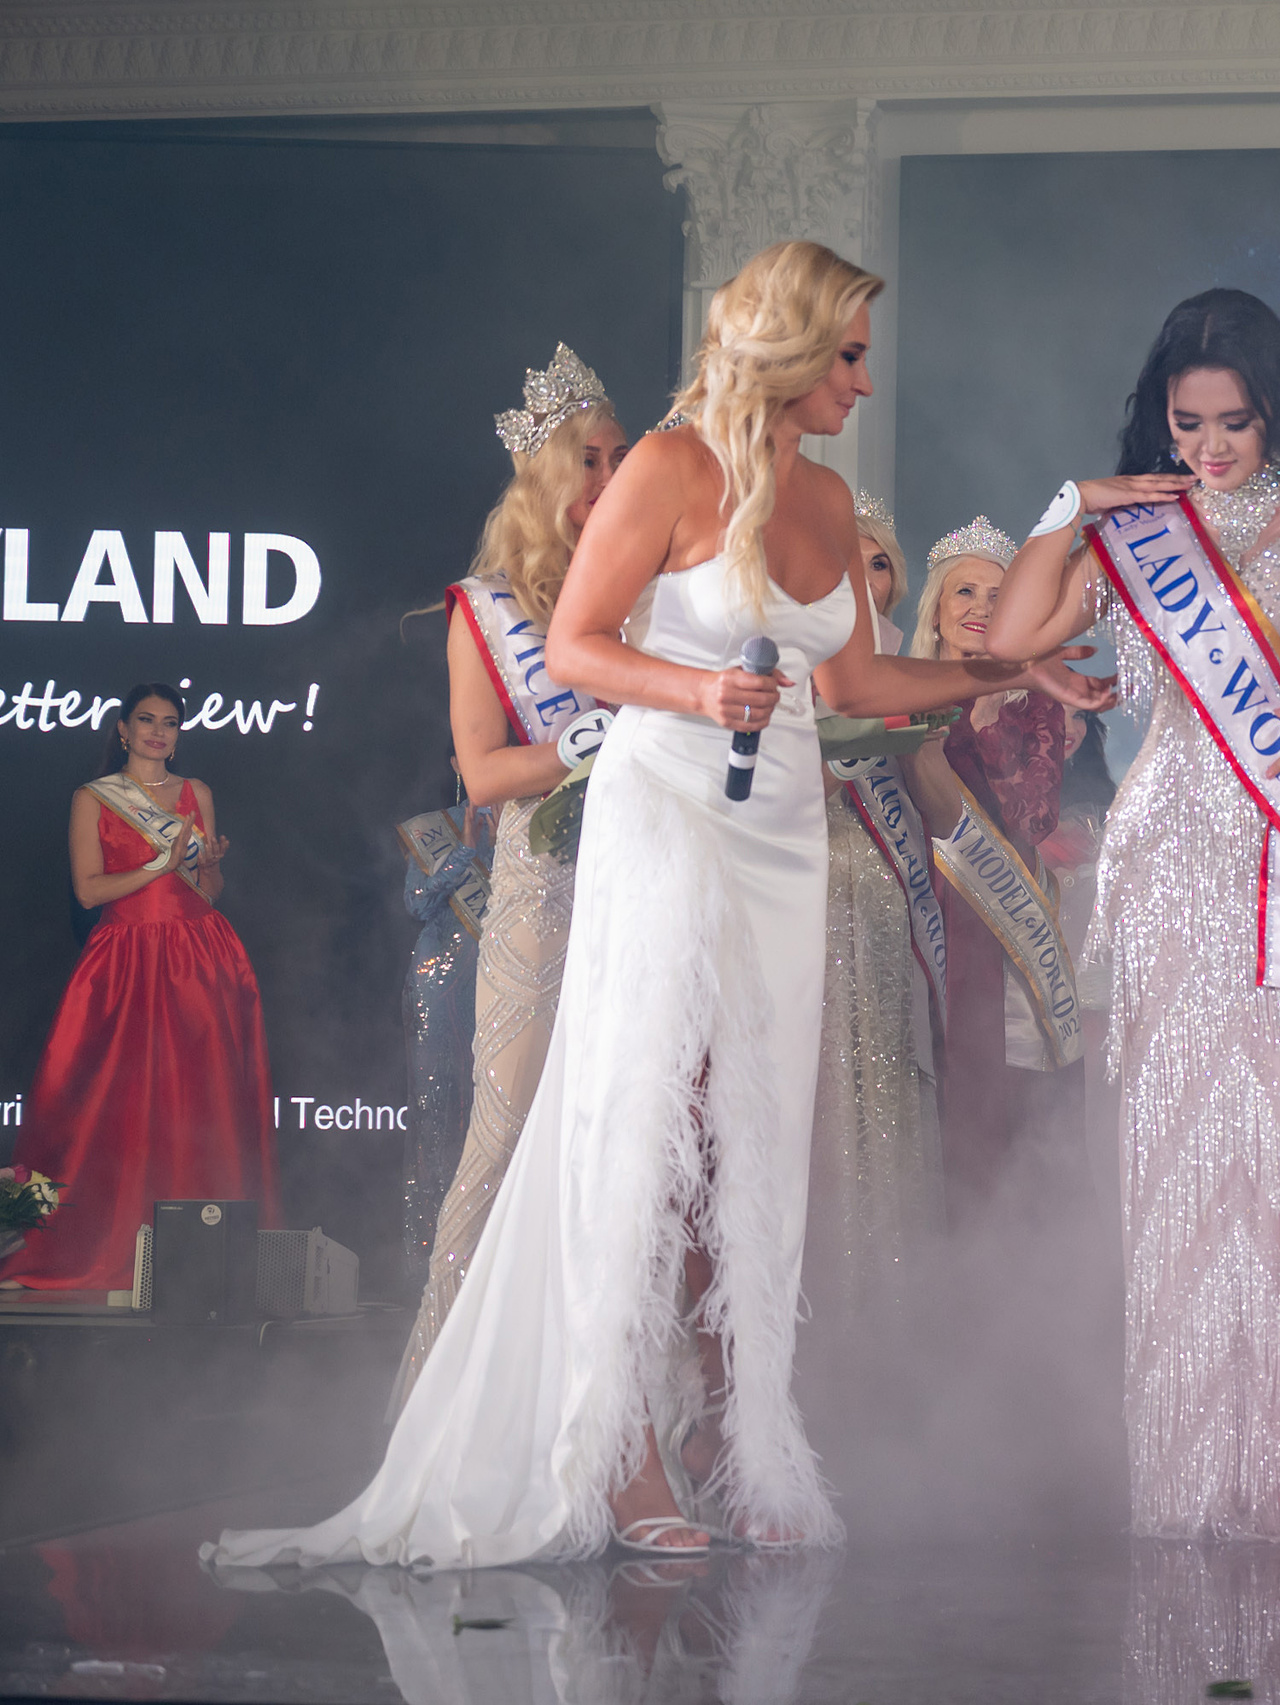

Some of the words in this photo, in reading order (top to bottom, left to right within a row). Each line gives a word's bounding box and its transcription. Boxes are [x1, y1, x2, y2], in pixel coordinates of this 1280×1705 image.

[0, 527, 322, 627] LAND
[1125, 524, 1228, 650] LADY
[0, 679, 122, 732] tter
[180, 678, 320, 735] iew!
[505, 619, 581, 727] VICE
[959, 834, 1034, 923] MODEL
[1027, 921, 1075, 1019] WORLD
[1058, 1014, 1081, 1041] 202
